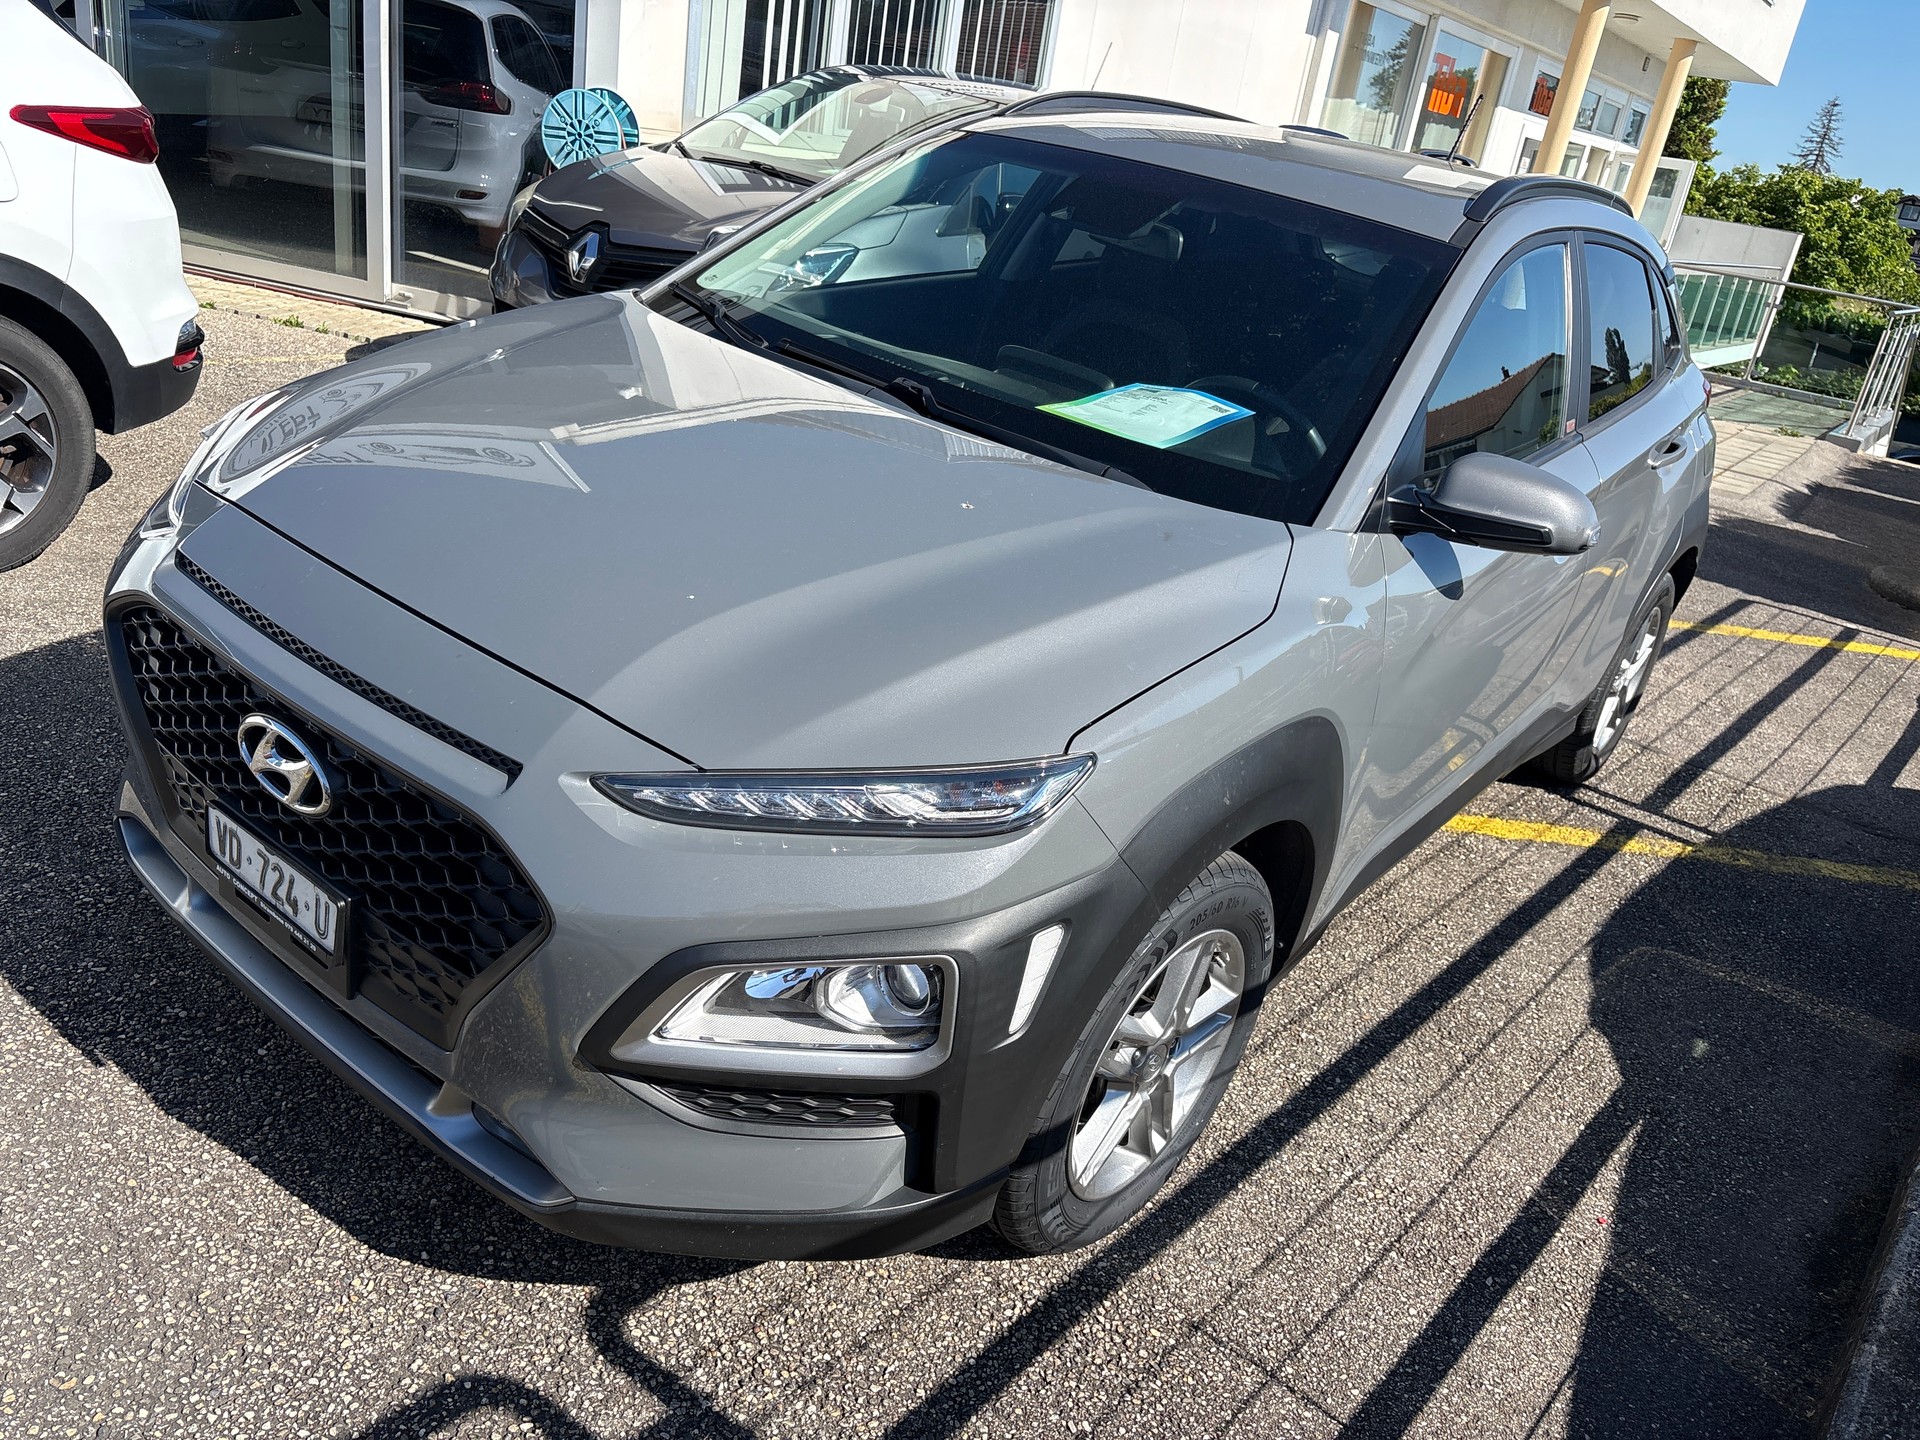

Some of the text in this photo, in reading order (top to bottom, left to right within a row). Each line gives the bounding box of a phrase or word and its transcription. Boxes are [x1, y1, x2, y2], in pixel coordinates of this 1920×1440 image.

[216, 864, 231, 880] AUTO
[233, 878, 257, 901] CONCEPT
[1190, 901, 1224, 931] 205/60
[1225, 897, 1240, 911] R16
